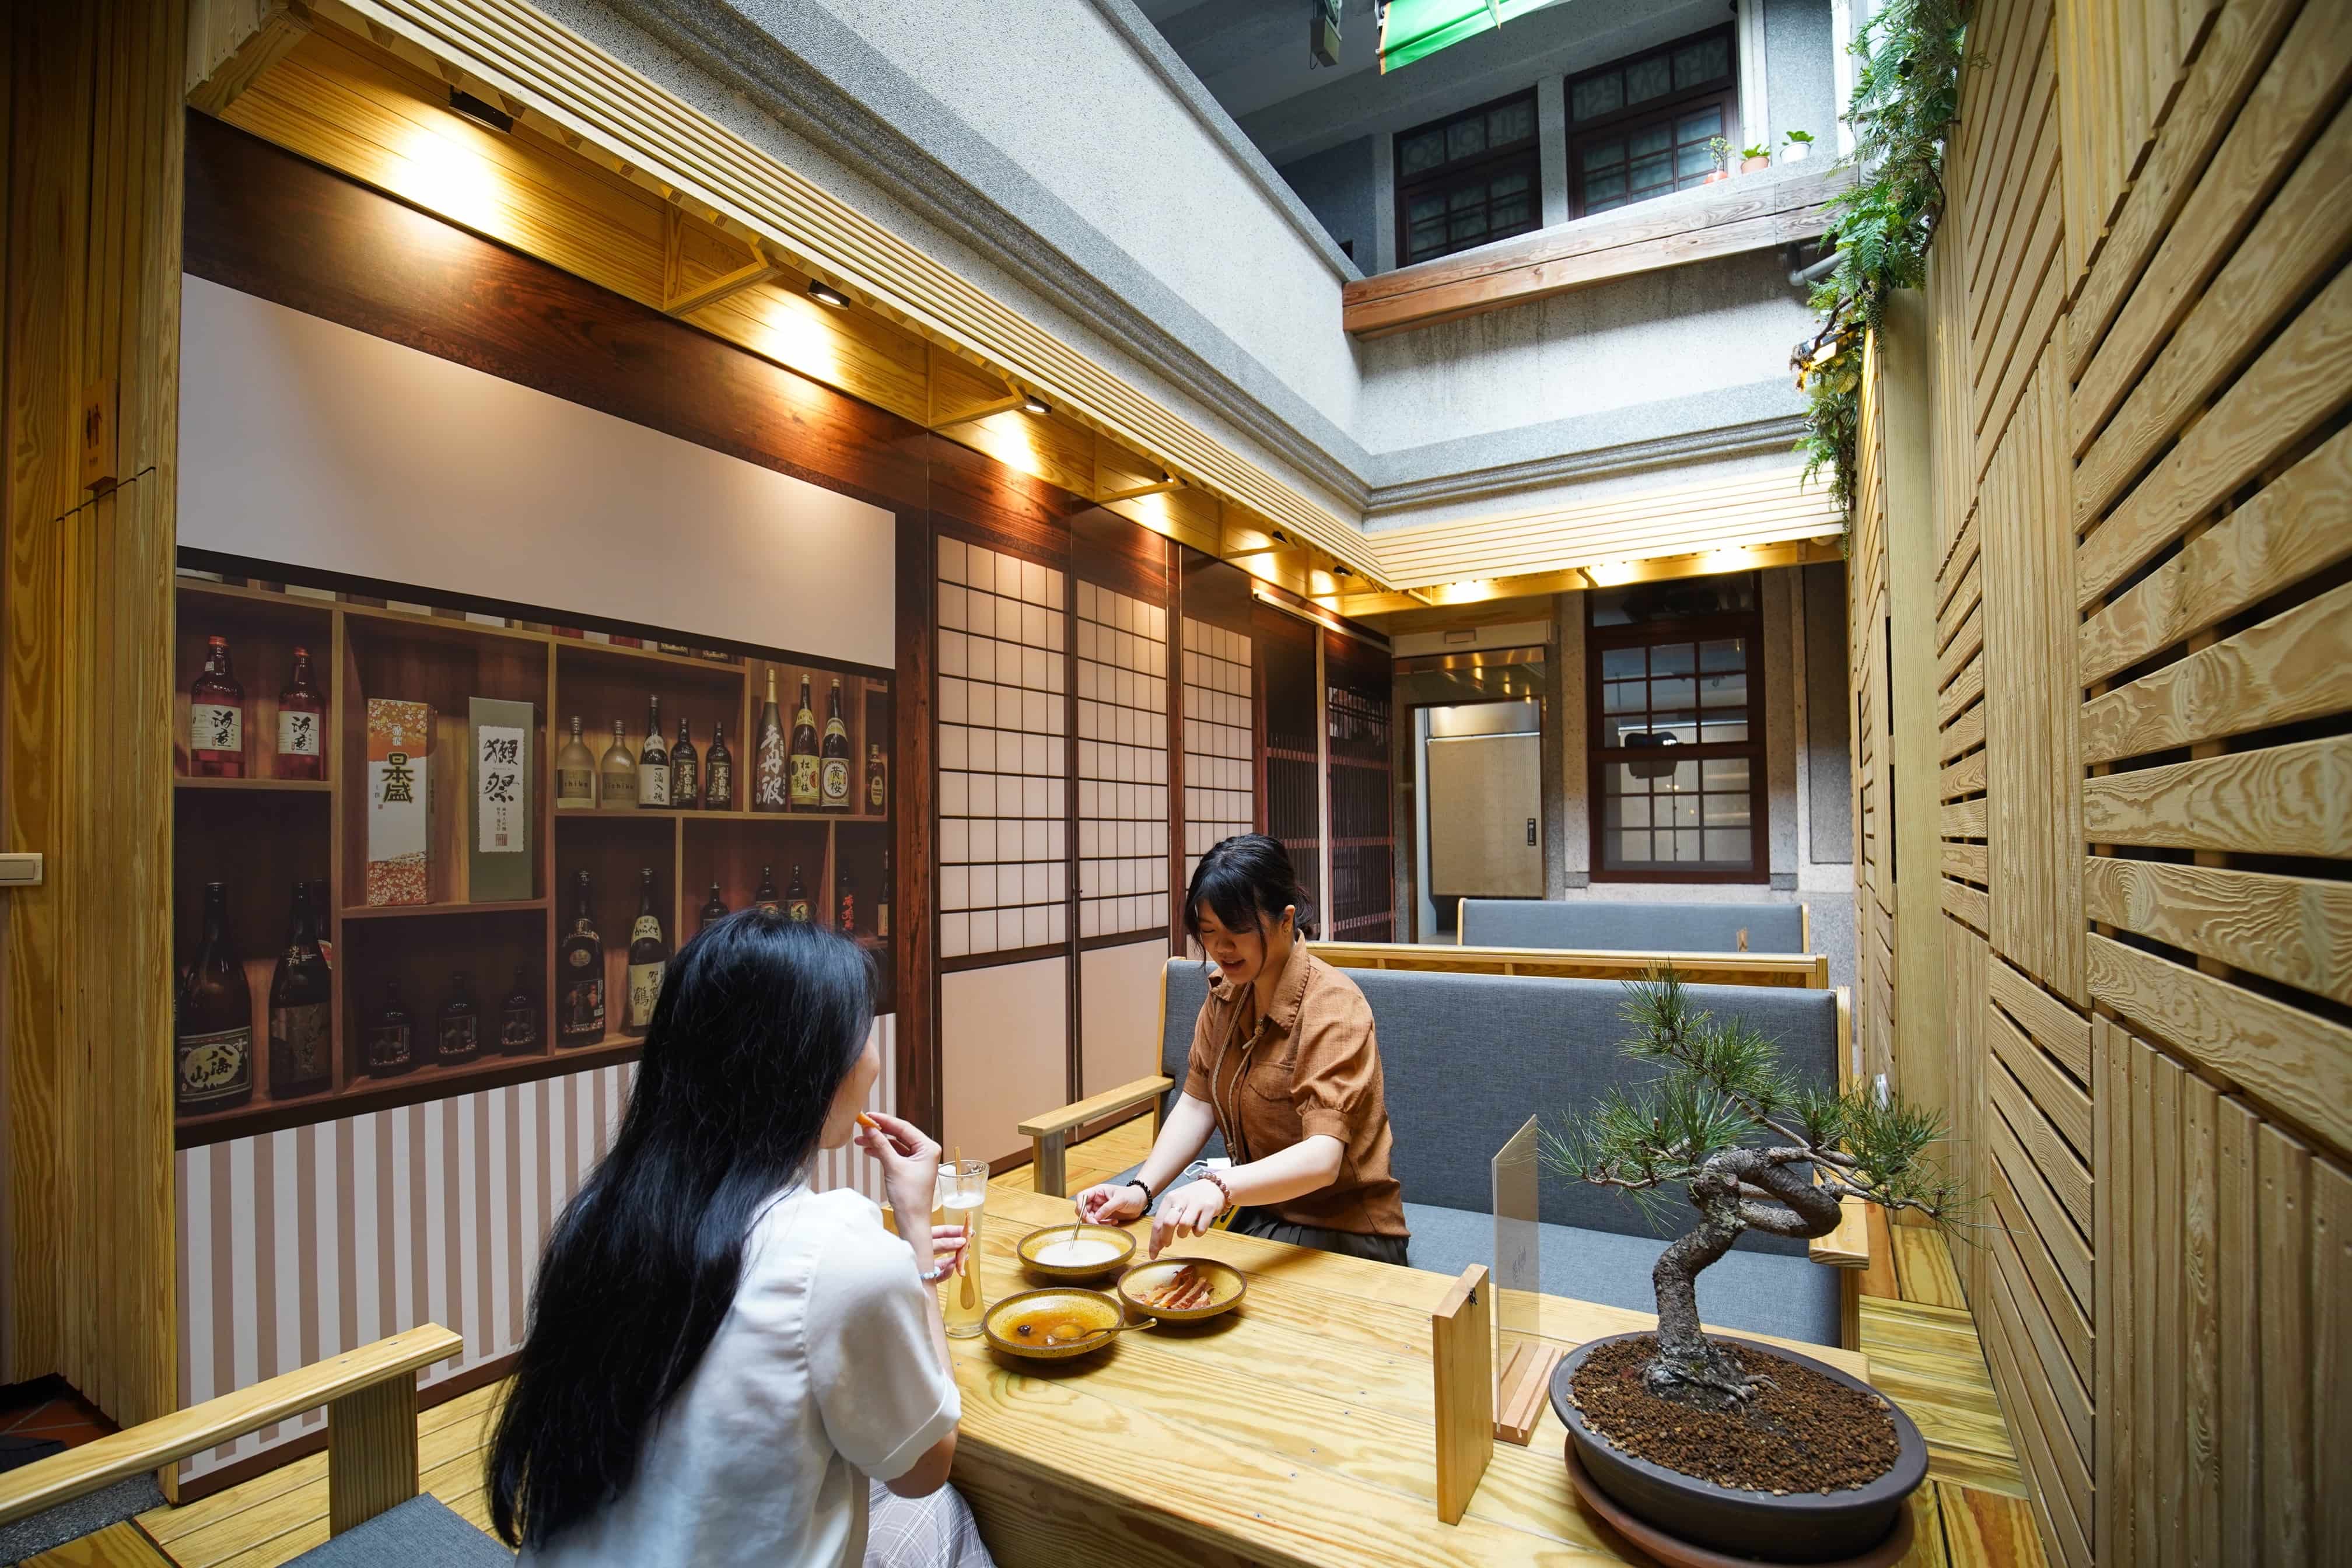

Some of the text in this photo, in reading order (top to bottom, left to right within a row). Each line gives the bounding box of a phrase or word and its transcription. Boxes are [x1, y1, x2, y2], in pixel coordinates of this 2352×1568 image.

[382, 753, 414, 803] 日本盛
[760, 724, 783, 804] 辛丹波
[800, 758, 810, 792] 松竹梅
[830, 765, 842, 794] 黄桜
[635, 925, 659, 936] からくち
[190, 1045, 233, 1083] 八海山
